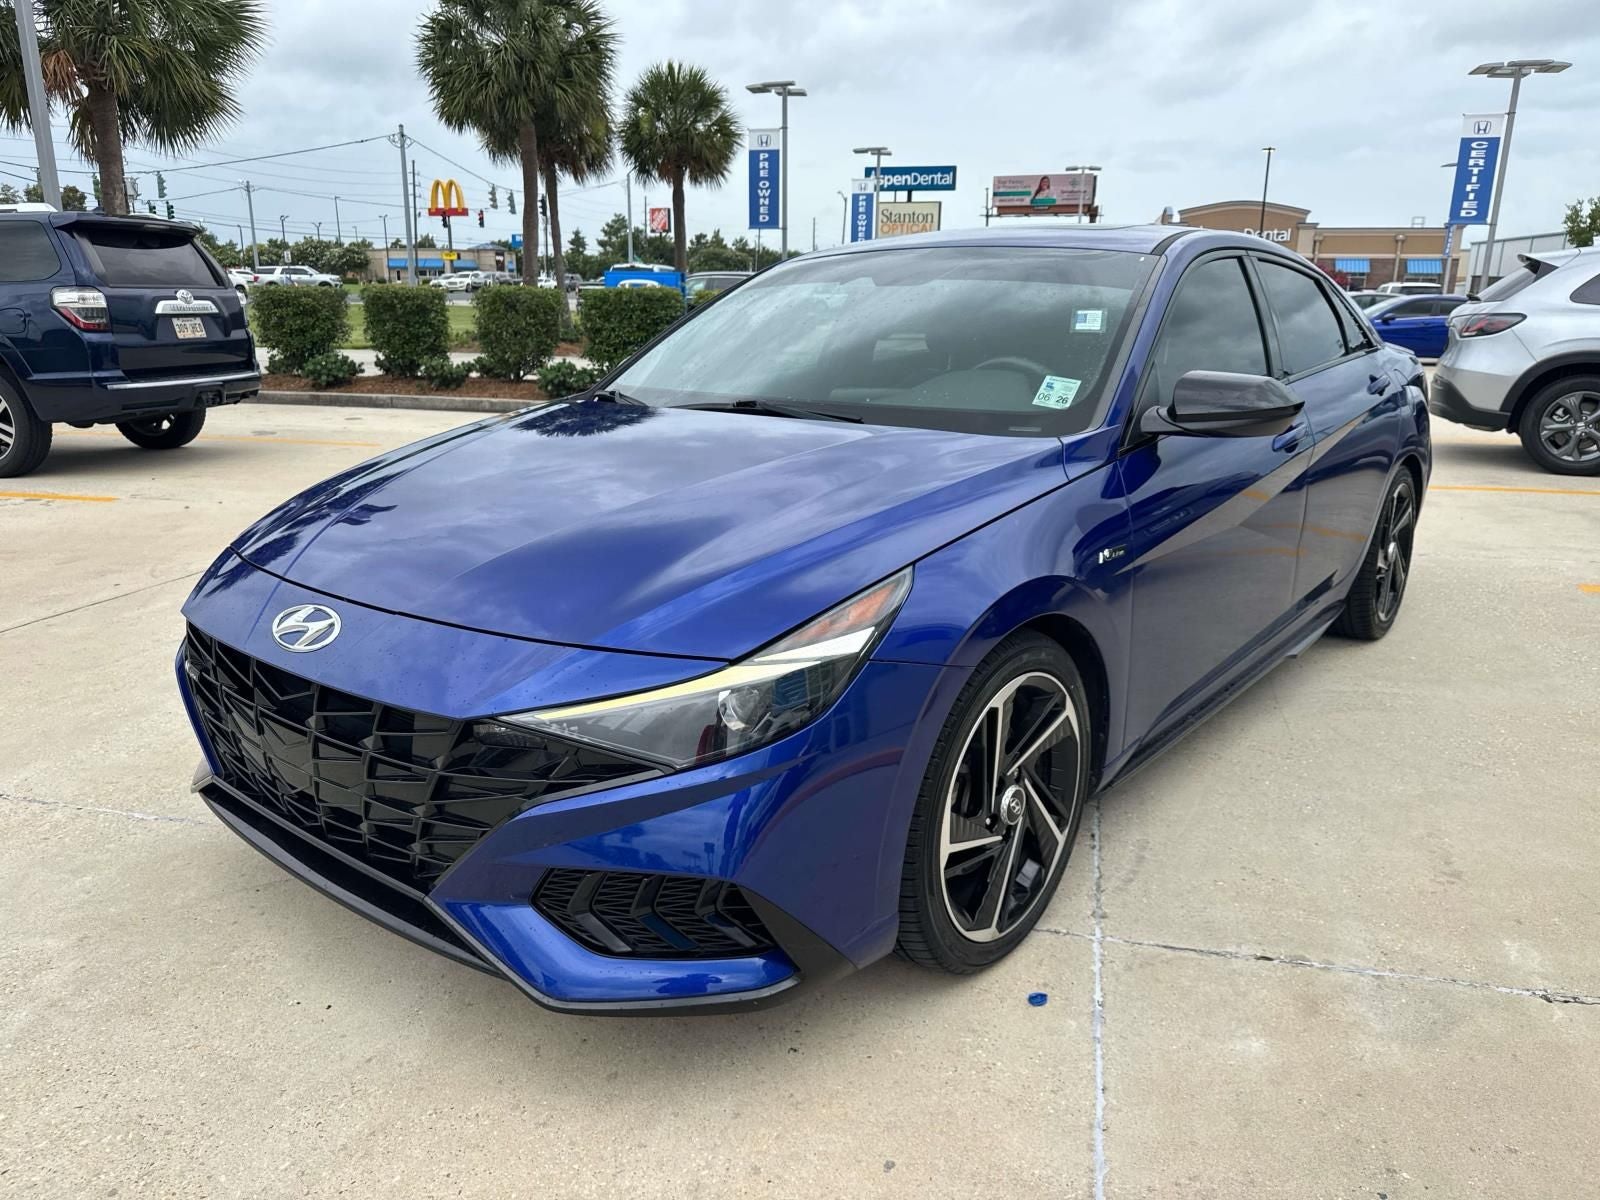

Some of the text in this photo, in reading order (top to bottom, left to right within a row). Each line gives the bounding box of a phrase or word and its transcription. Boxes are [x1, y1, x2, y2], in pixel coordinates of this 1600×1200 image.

[757, 152, 771, 223] PRE OWNED
[1460, 141, 1489, 217] CERTIFIED
[880, 208, 935, 224] Stanton
[1038, 393, 1069, 404] 06 26
